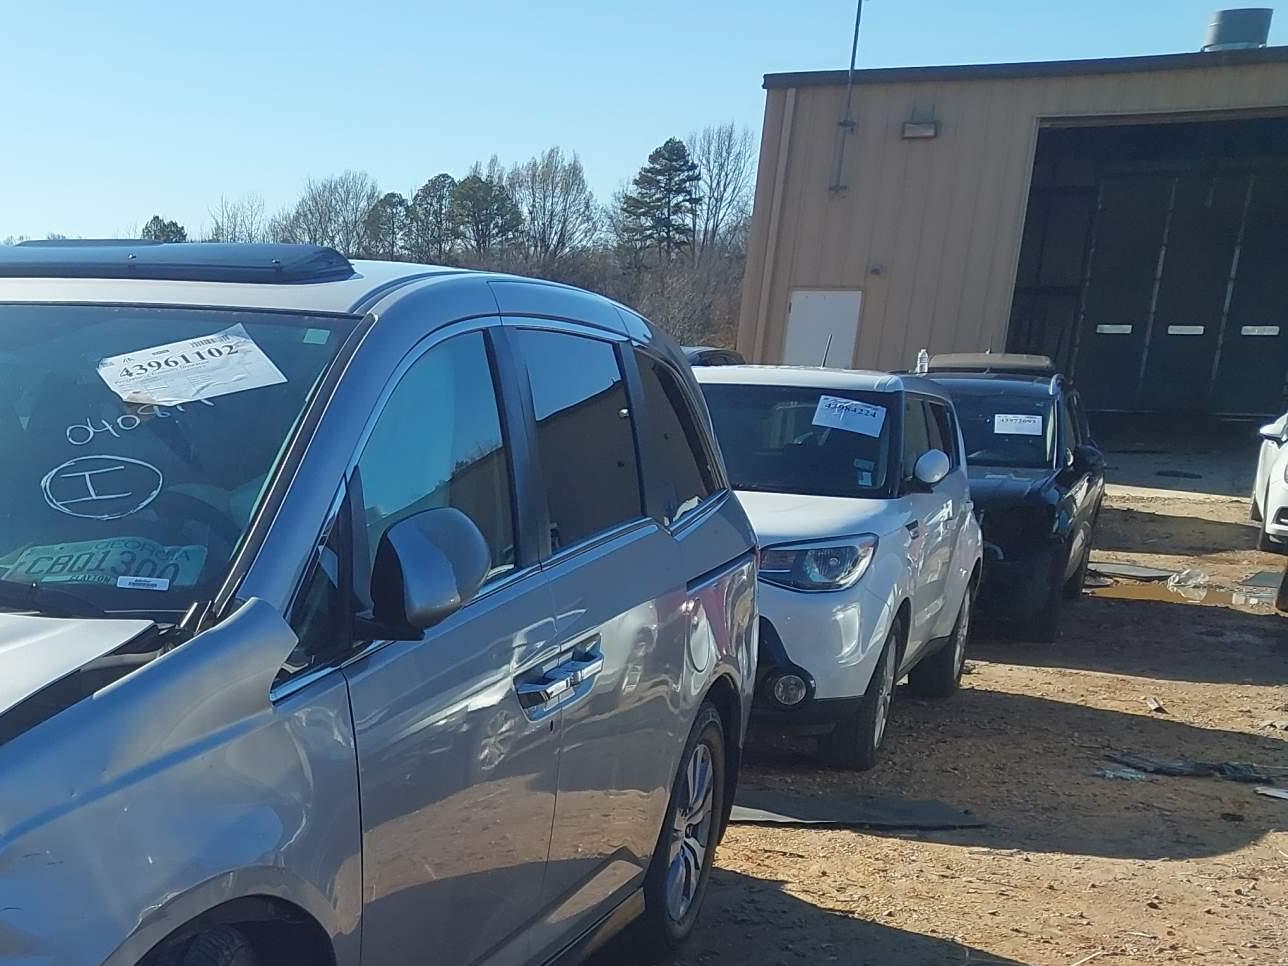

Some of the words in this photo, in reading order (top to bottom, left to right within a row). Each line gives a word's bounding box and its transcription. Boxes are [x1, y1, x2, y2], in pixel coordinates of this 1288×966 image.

[119, 344, 240, 378] 43961102
[94, 538, 191, 561] GEORGIA
[70, 574, 112, 584] CLAYTON
